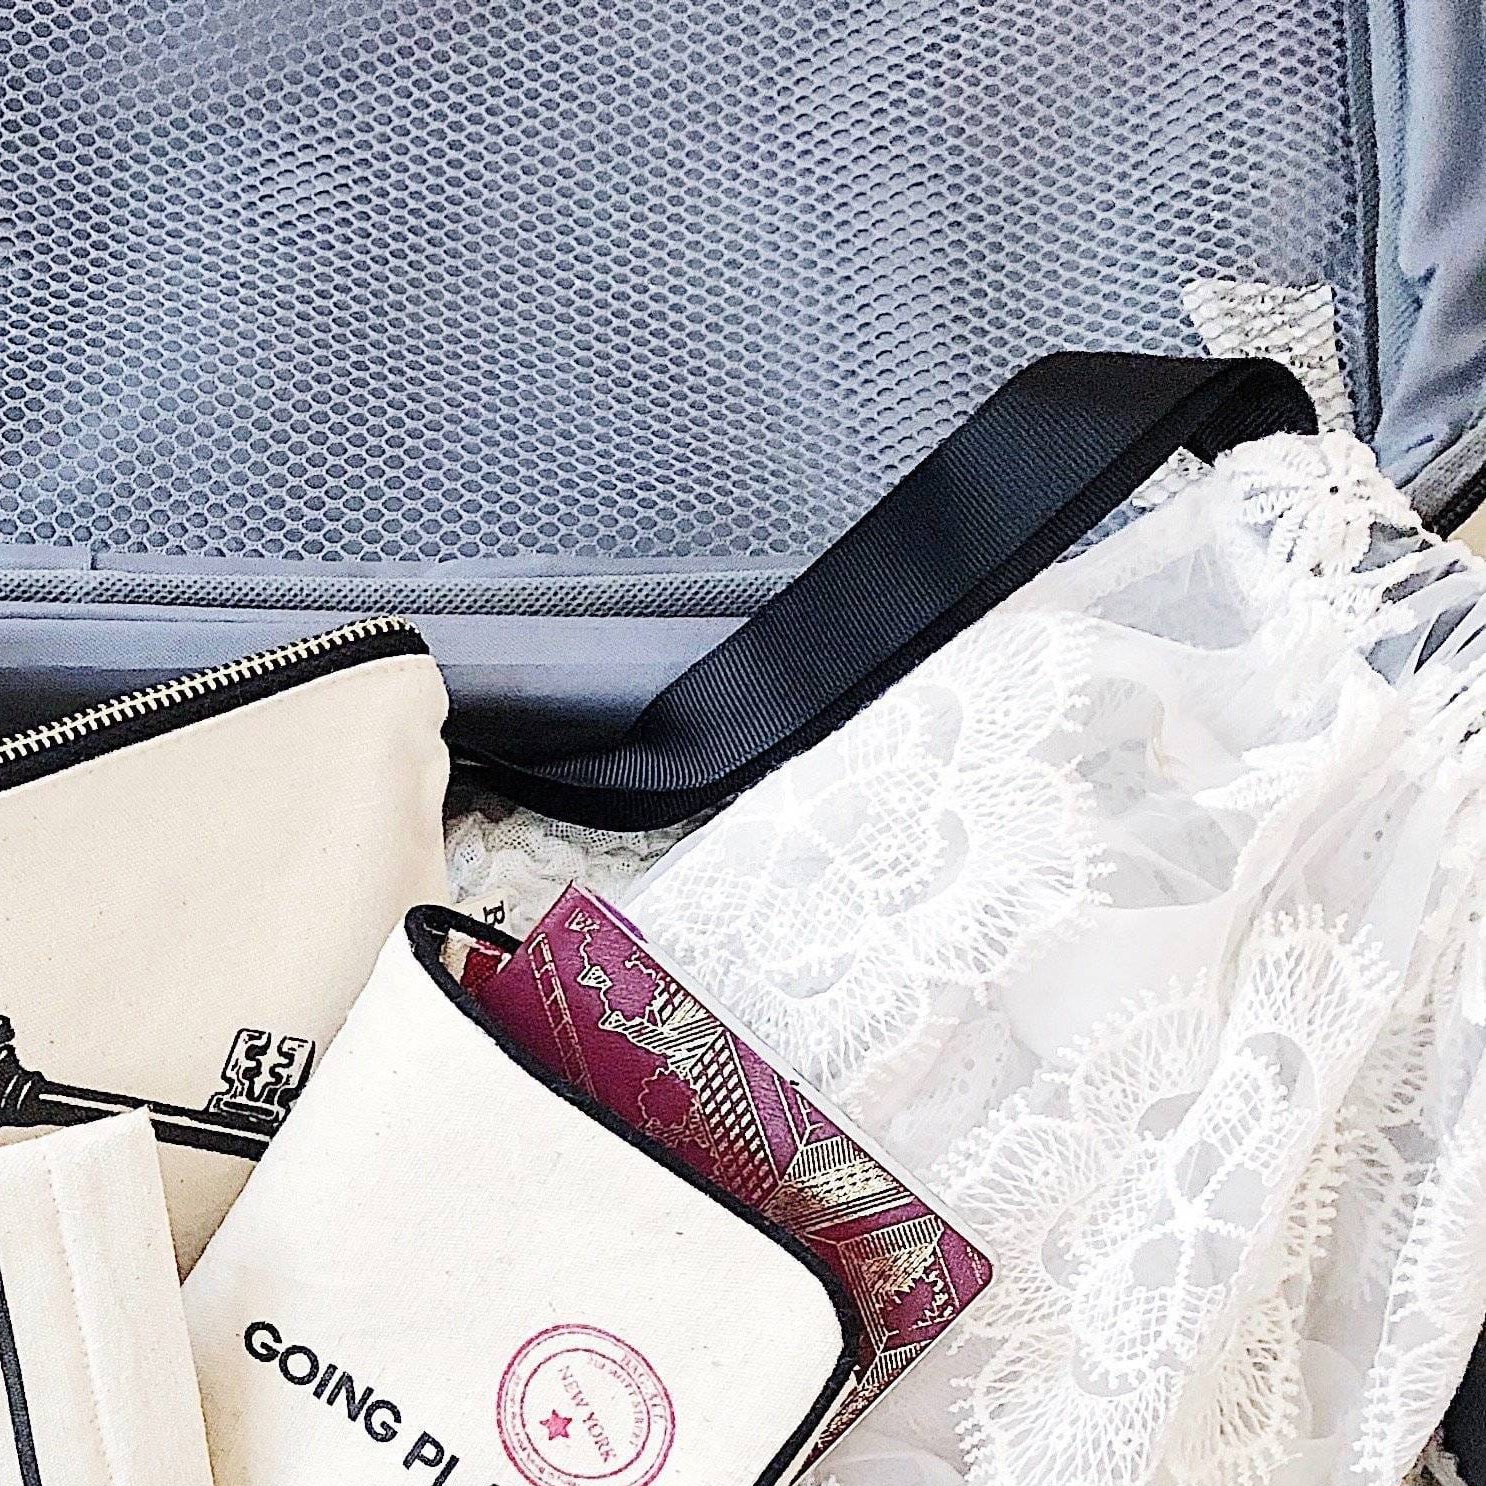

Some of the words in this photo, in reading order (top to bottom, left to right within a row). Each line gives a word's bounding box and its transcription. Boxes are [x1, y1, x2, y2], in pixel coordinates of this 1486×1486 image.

[244, 1321, 402, 1443] GOING
[557, 1365, 590, 1407] NEW
[582, 1411, 616, 1463] YORK
